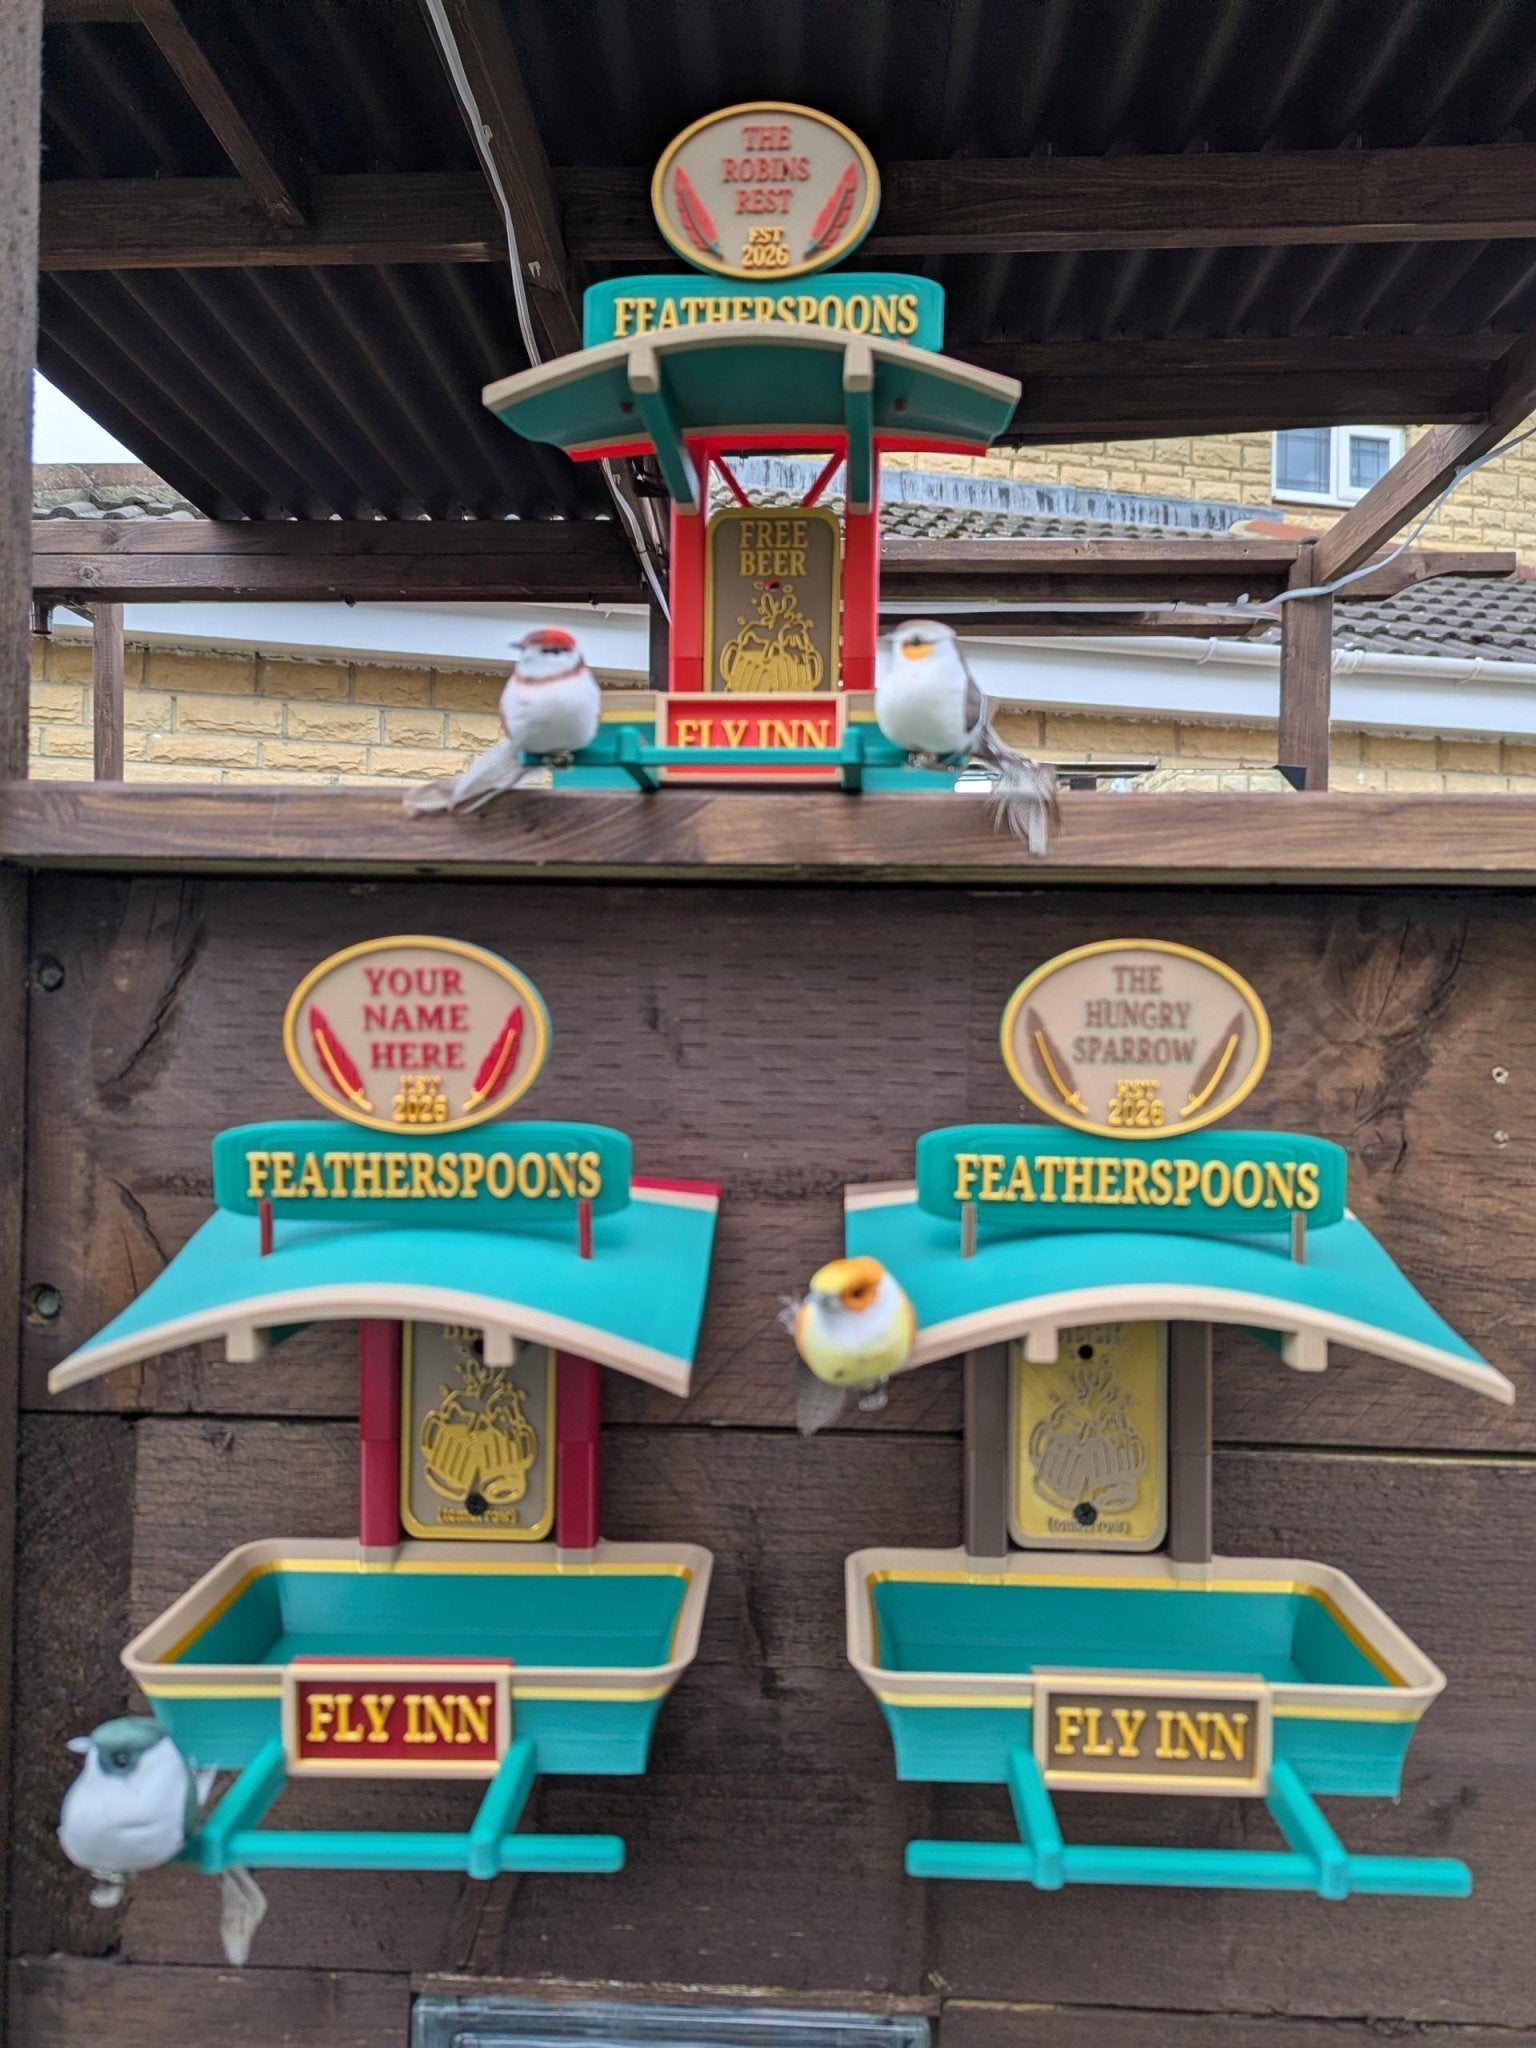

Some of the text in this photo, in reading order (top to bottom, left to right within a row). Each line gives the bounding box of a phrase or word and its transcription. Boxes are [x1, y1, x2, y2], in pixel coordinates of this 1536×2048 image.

[743, 126, 791, 151] THE
[722, 158, 810, 183] ROBINS
[735, 190, 793, 215] REST
[748, 226, 784, 243] EST
[741, 243, 789, 268] 2026
[613, 295, 918, 338] FEATHERSPOONS
[739, 520, 808, 548] FREE
[739, 550, 807, 577] BEER
[758, 719, 830, 749] INN
[363, 967, 463, 996] YOUR
[1113, 965, 1163, 994] THE
[363, 1004, 468, 1032] NAME
[1085, 1000, 1191, 1030] HUNGRY
[371, 1041, 465, 1070] HERE
[1072, 1037, 1197, 1066] SPARROW
[246, 1151, 601, 1199] FEATHERSPOONS
[955, 1154, 1319, 1209] FEATHERSPOONS
[306, 1694, 492, 1743] FLY INN
[1054, 1706, 1248, 1762] FLY INN
